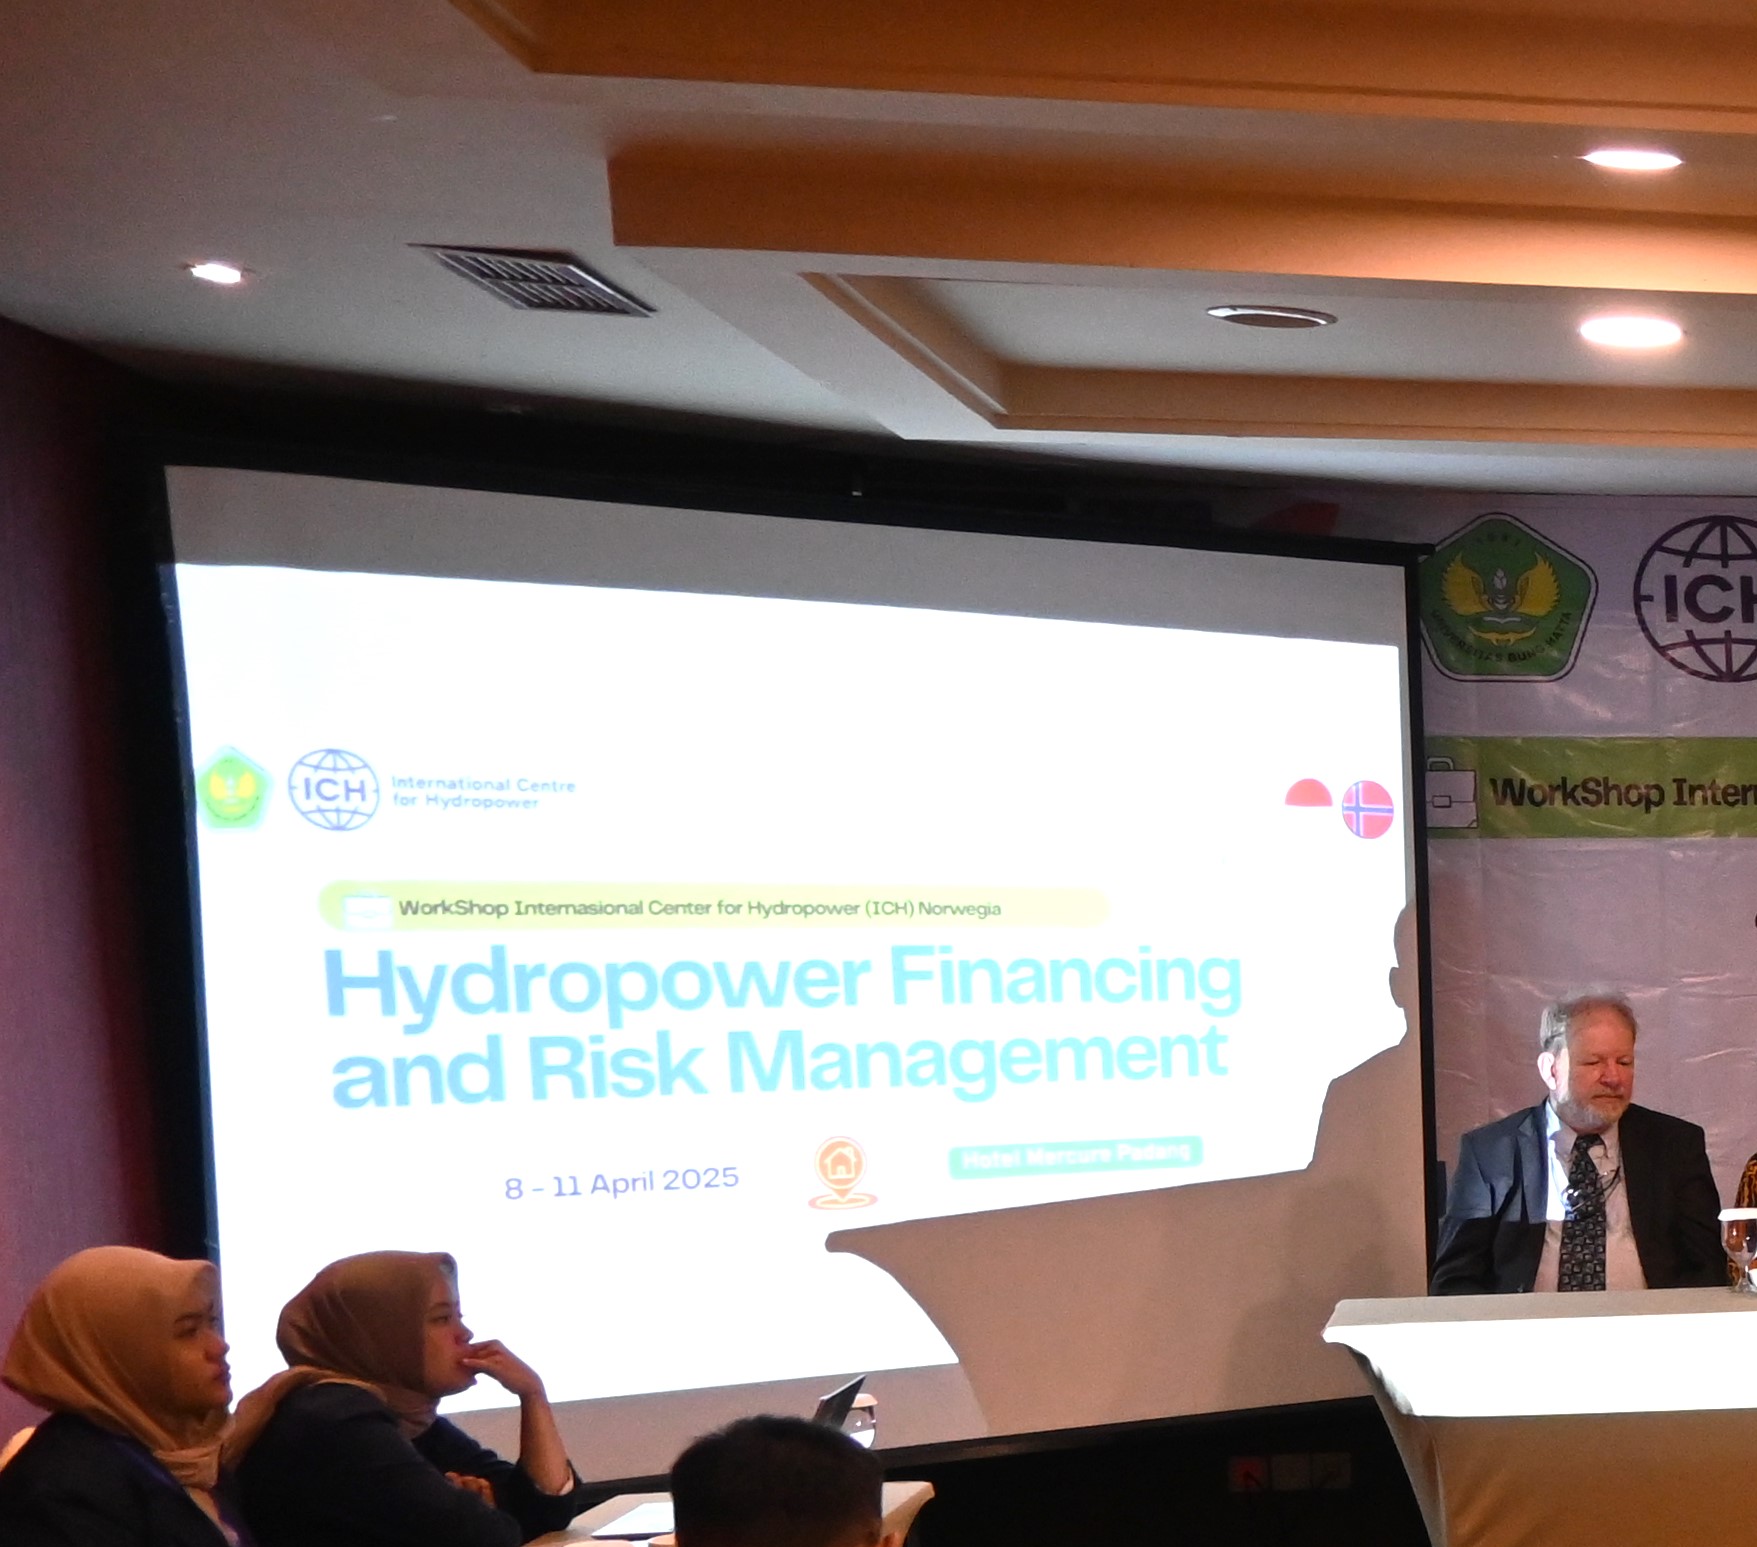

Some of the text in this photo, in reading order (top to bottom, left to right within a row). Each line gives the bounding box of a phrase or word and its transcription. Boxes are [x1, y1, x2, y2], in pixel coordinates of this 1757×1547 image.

[303, 776, 368, 803] ICH
[391, 775, 577, 794] International Centre
[1489, 776, 1666, 815] WorkShop
[392, 793, 541, 811] for Hydropower
[399, 899, 1002, 920] WorkShop Internasional Center for Hydropower (ICH) Norwegia
[323, 943, 1243, 1036] Hydropower Financing
[331, 1024, 1231, 1110] and Risk Management
[962, 1149, 1022, 1170] Hotel
[1026, 1147, 1111, 1167] Mercure
[505, 1177, 524, 1200] 8
[553, 1175, 582, 1198] 11
[590, 1169, 654, 1200] April
[662, 1166, 740, 1191] 2025
